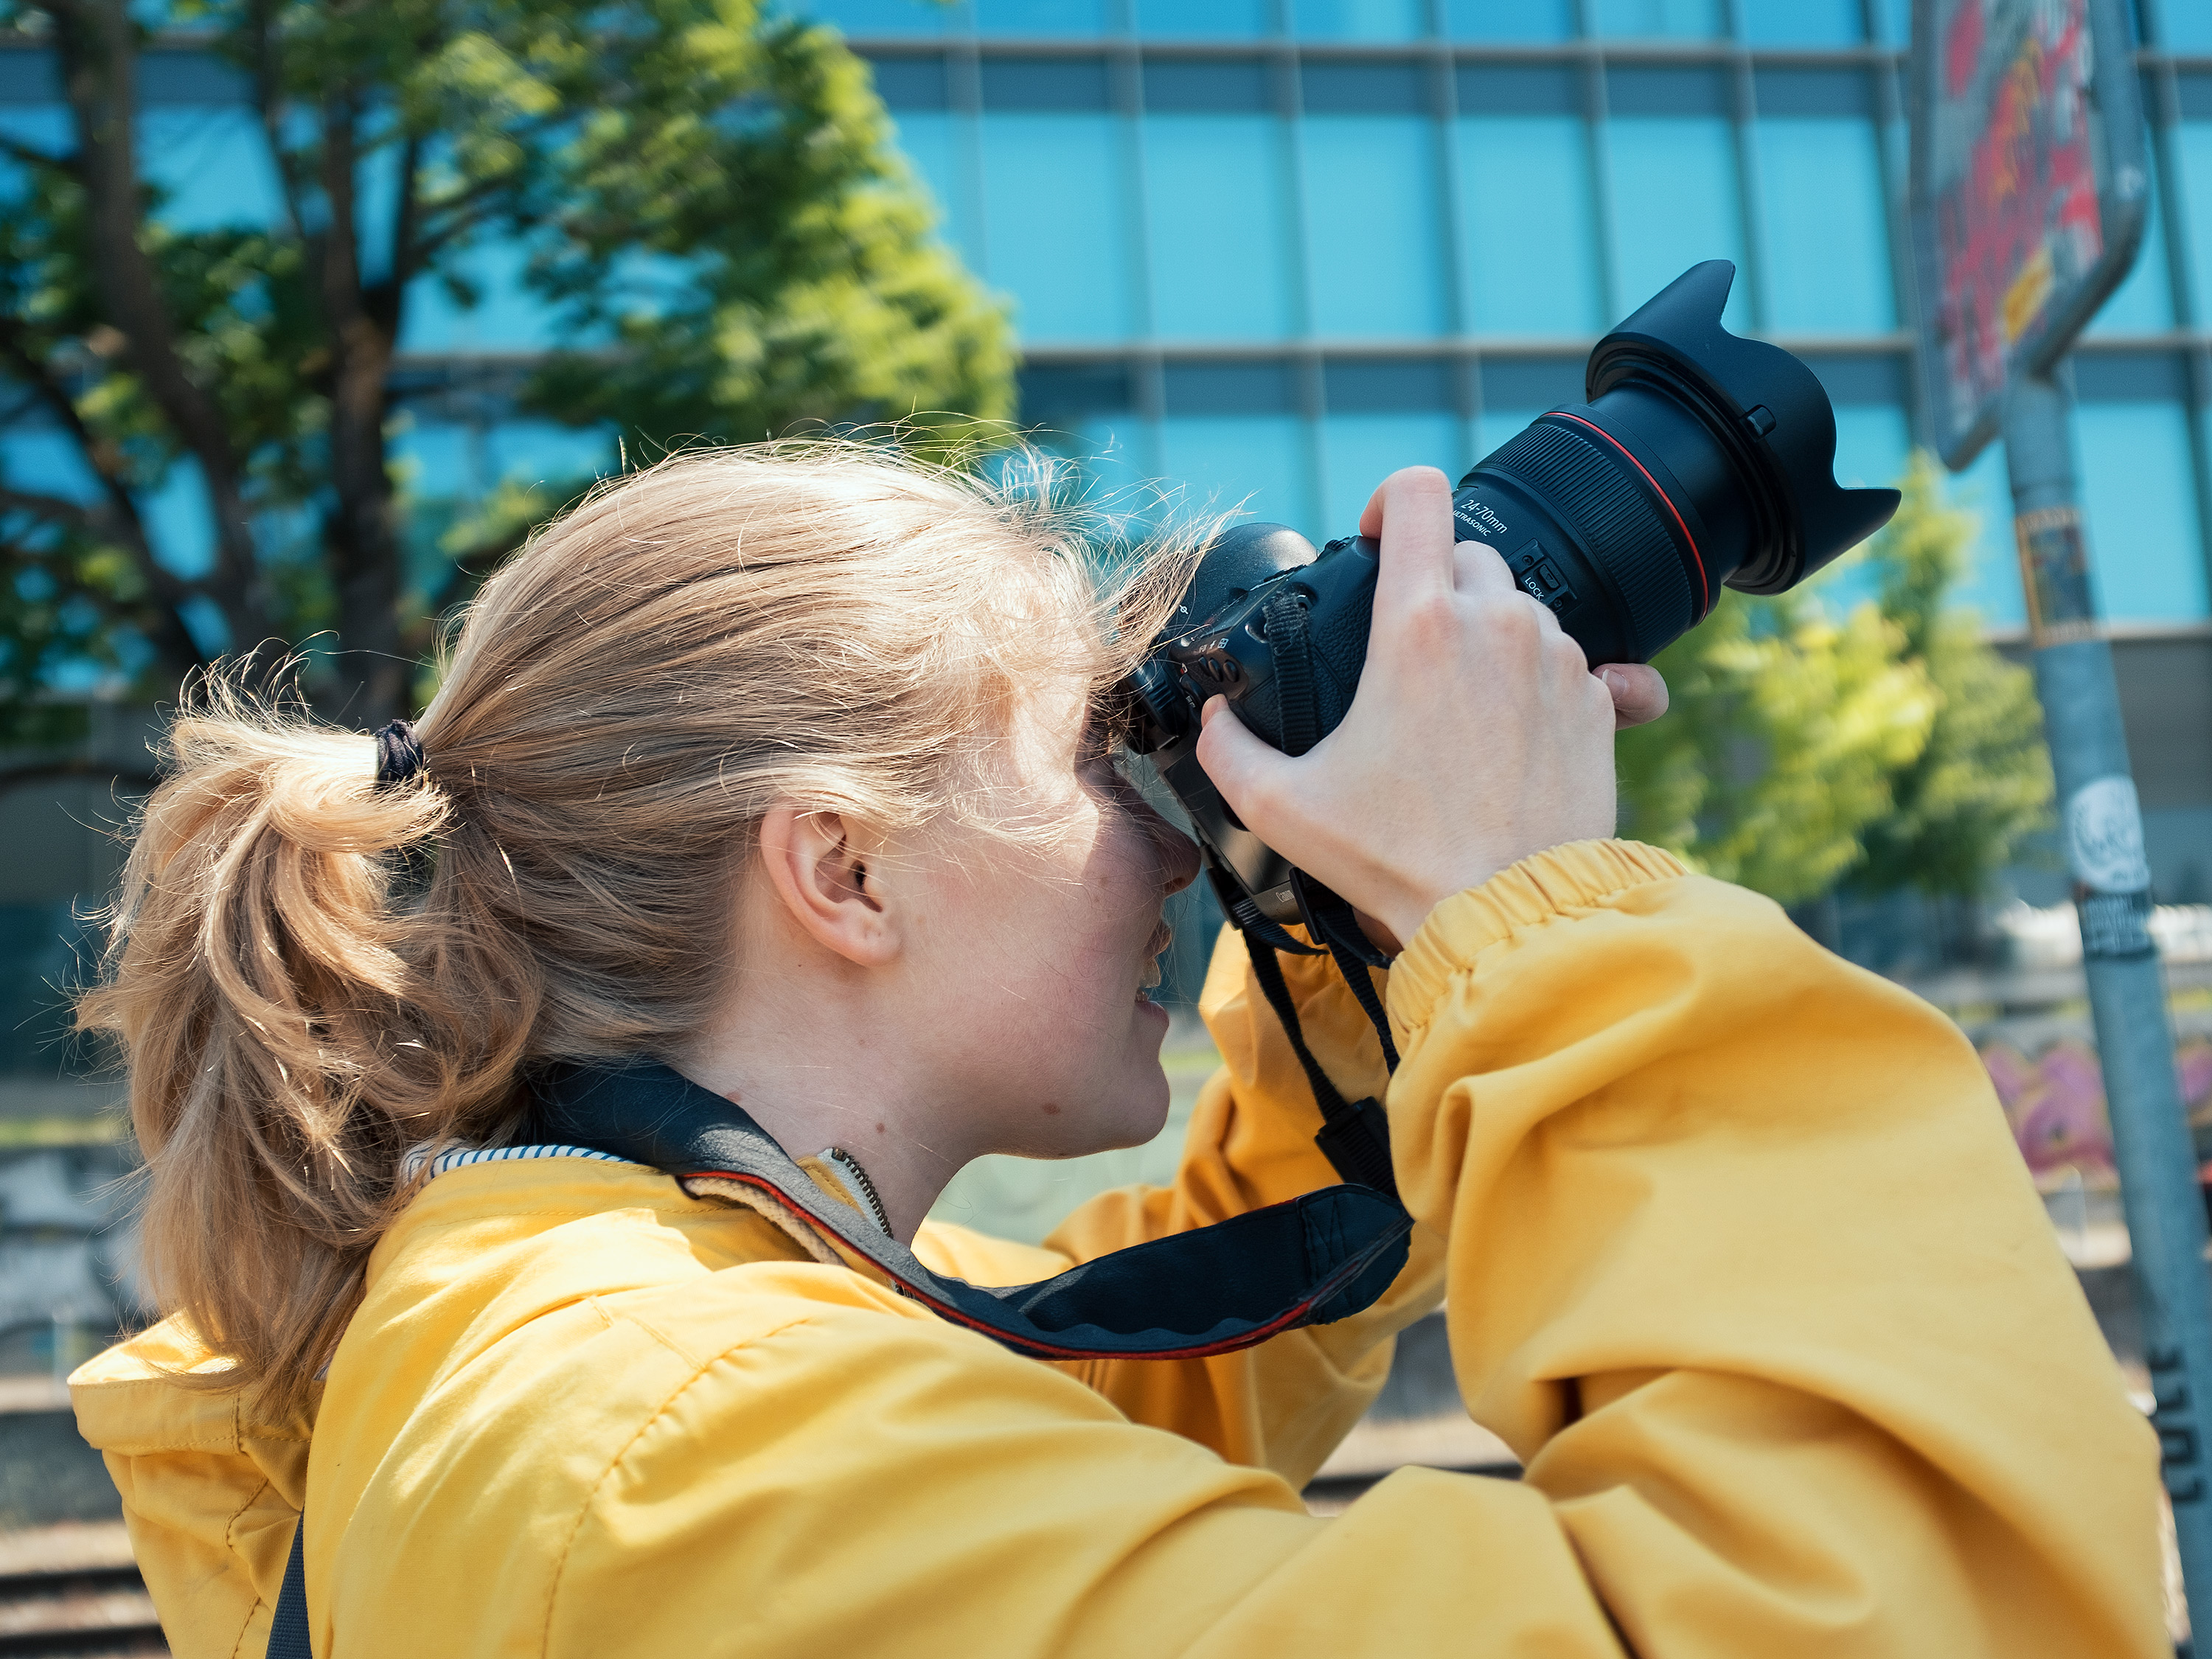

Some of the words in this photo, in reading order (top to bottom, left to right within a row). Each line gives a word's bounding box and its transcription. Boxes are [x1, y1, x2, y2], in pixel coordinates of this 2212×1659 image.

[1453, 509, 1492, 537] ULTRASONIC
[1461, 499, 1508, 534] 24-70mm
[1524, 577, 1545, 602] LOCK
[1276, 889, 1295, 903] Canon
